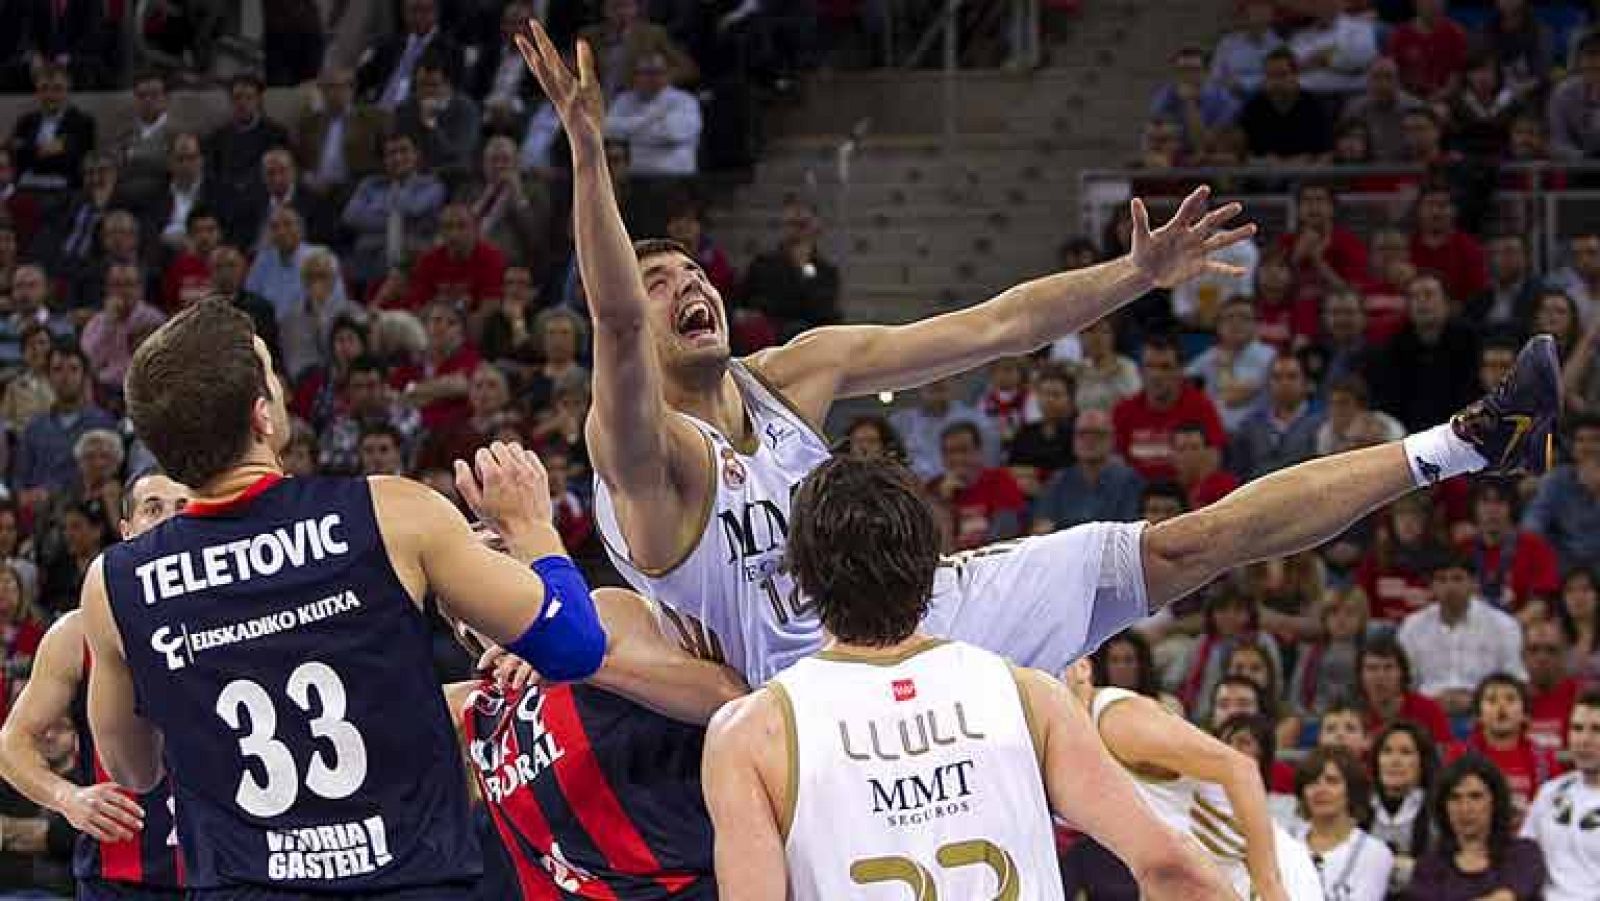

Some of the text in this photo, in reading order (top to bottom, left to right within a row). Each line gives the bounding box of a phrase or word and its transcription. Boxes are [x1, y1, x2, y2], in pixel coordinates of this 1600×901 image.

[135, 514, 349, 604] TELETOVIC
[190, 589, 361, 651] EUSKADIKO KUTXA
[216, 661, 368, 818] 33
[838, 701, 985, 760] LLULL
[867, 760, 974, 813] MMT
[887, 801, 970, 827] SEGUROS
